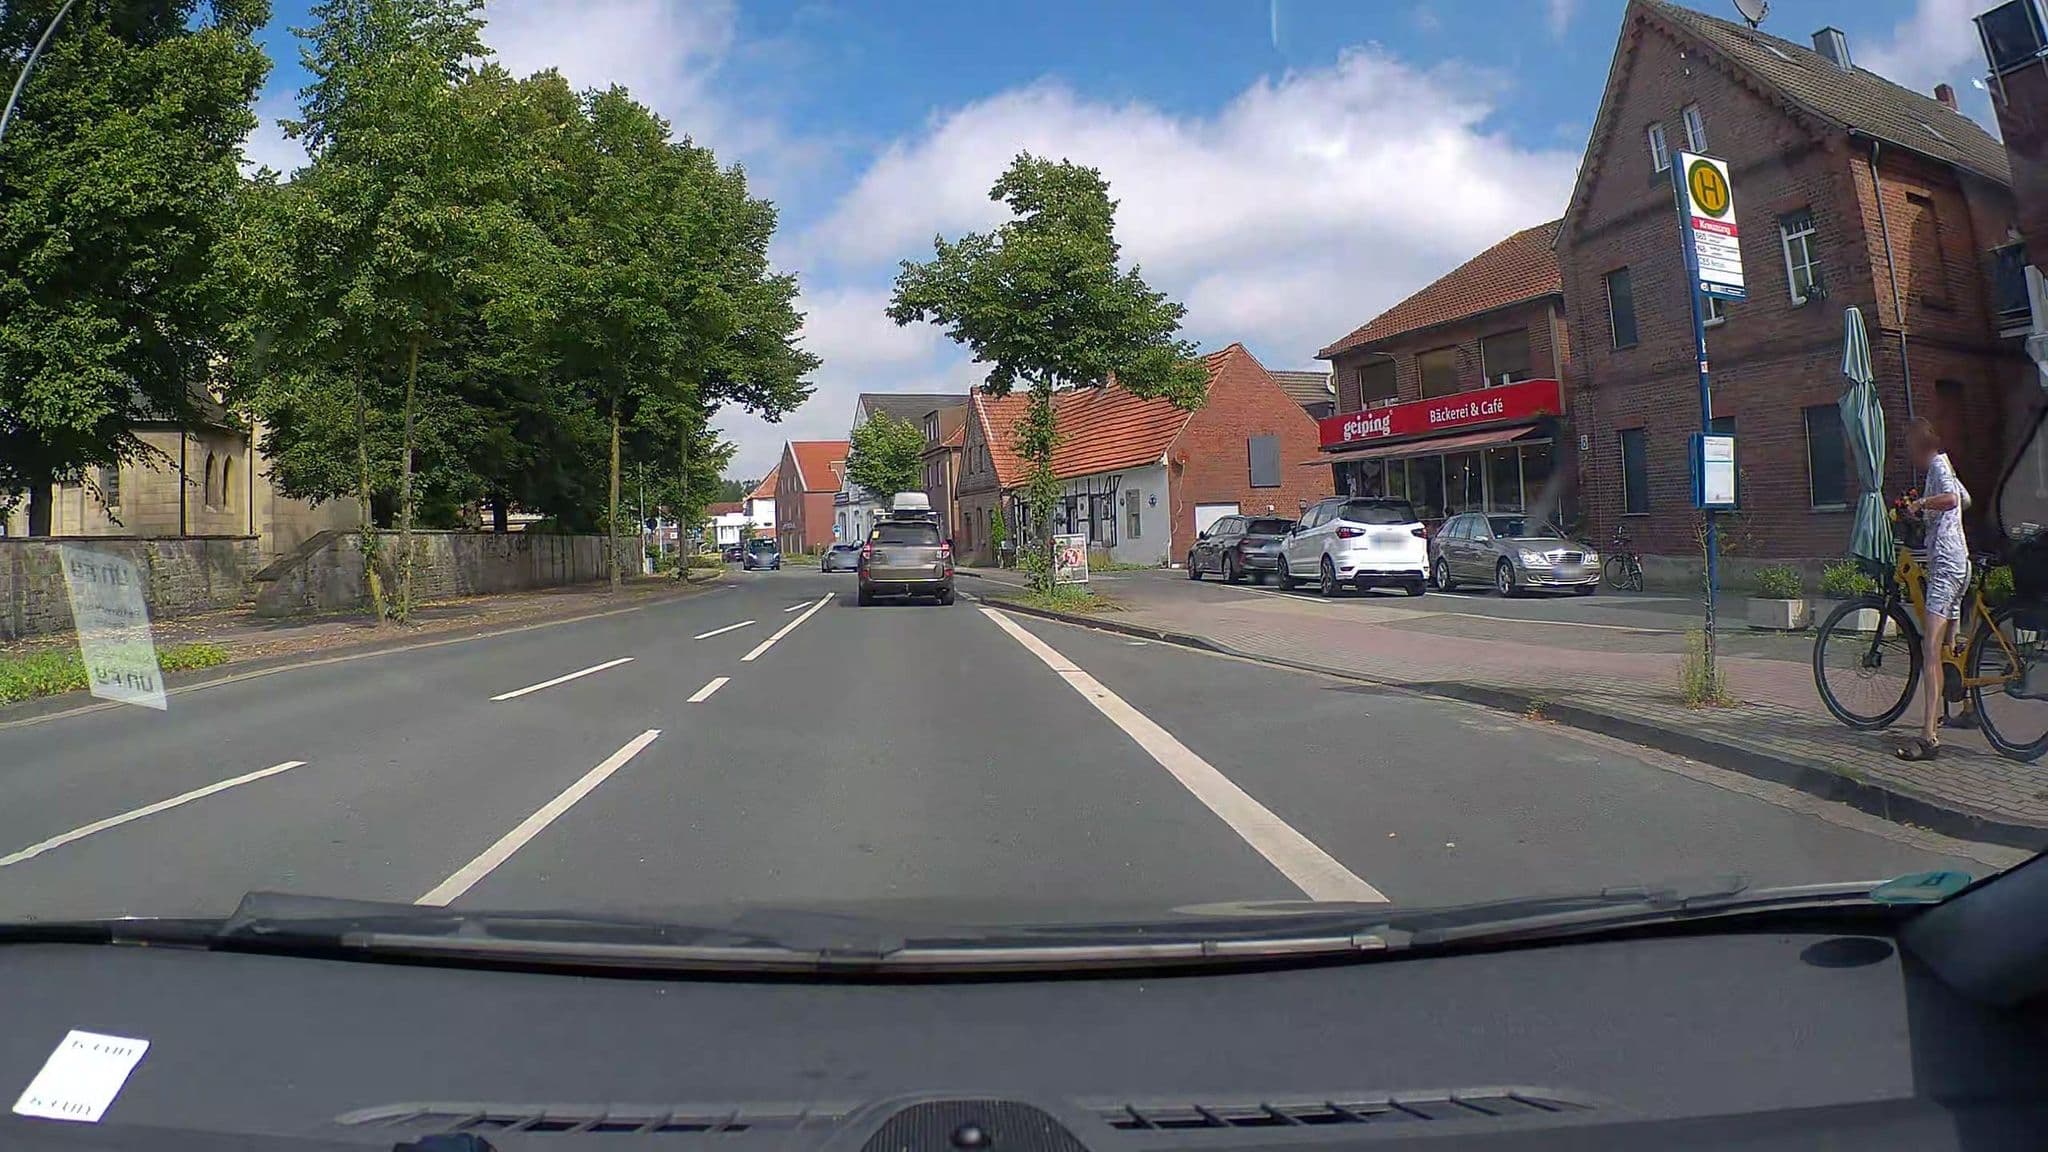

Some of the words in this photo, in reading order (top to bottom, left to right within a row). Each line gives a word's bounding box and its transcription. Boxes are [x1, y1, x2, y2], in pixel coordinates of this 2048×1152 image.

[1430, 404, 1469, 424] Bäckerei
[1471, 403, 1480, 416] &
[1481, 397, 1504, 414] Café
[1343, 412, 1391, 441] geiping
